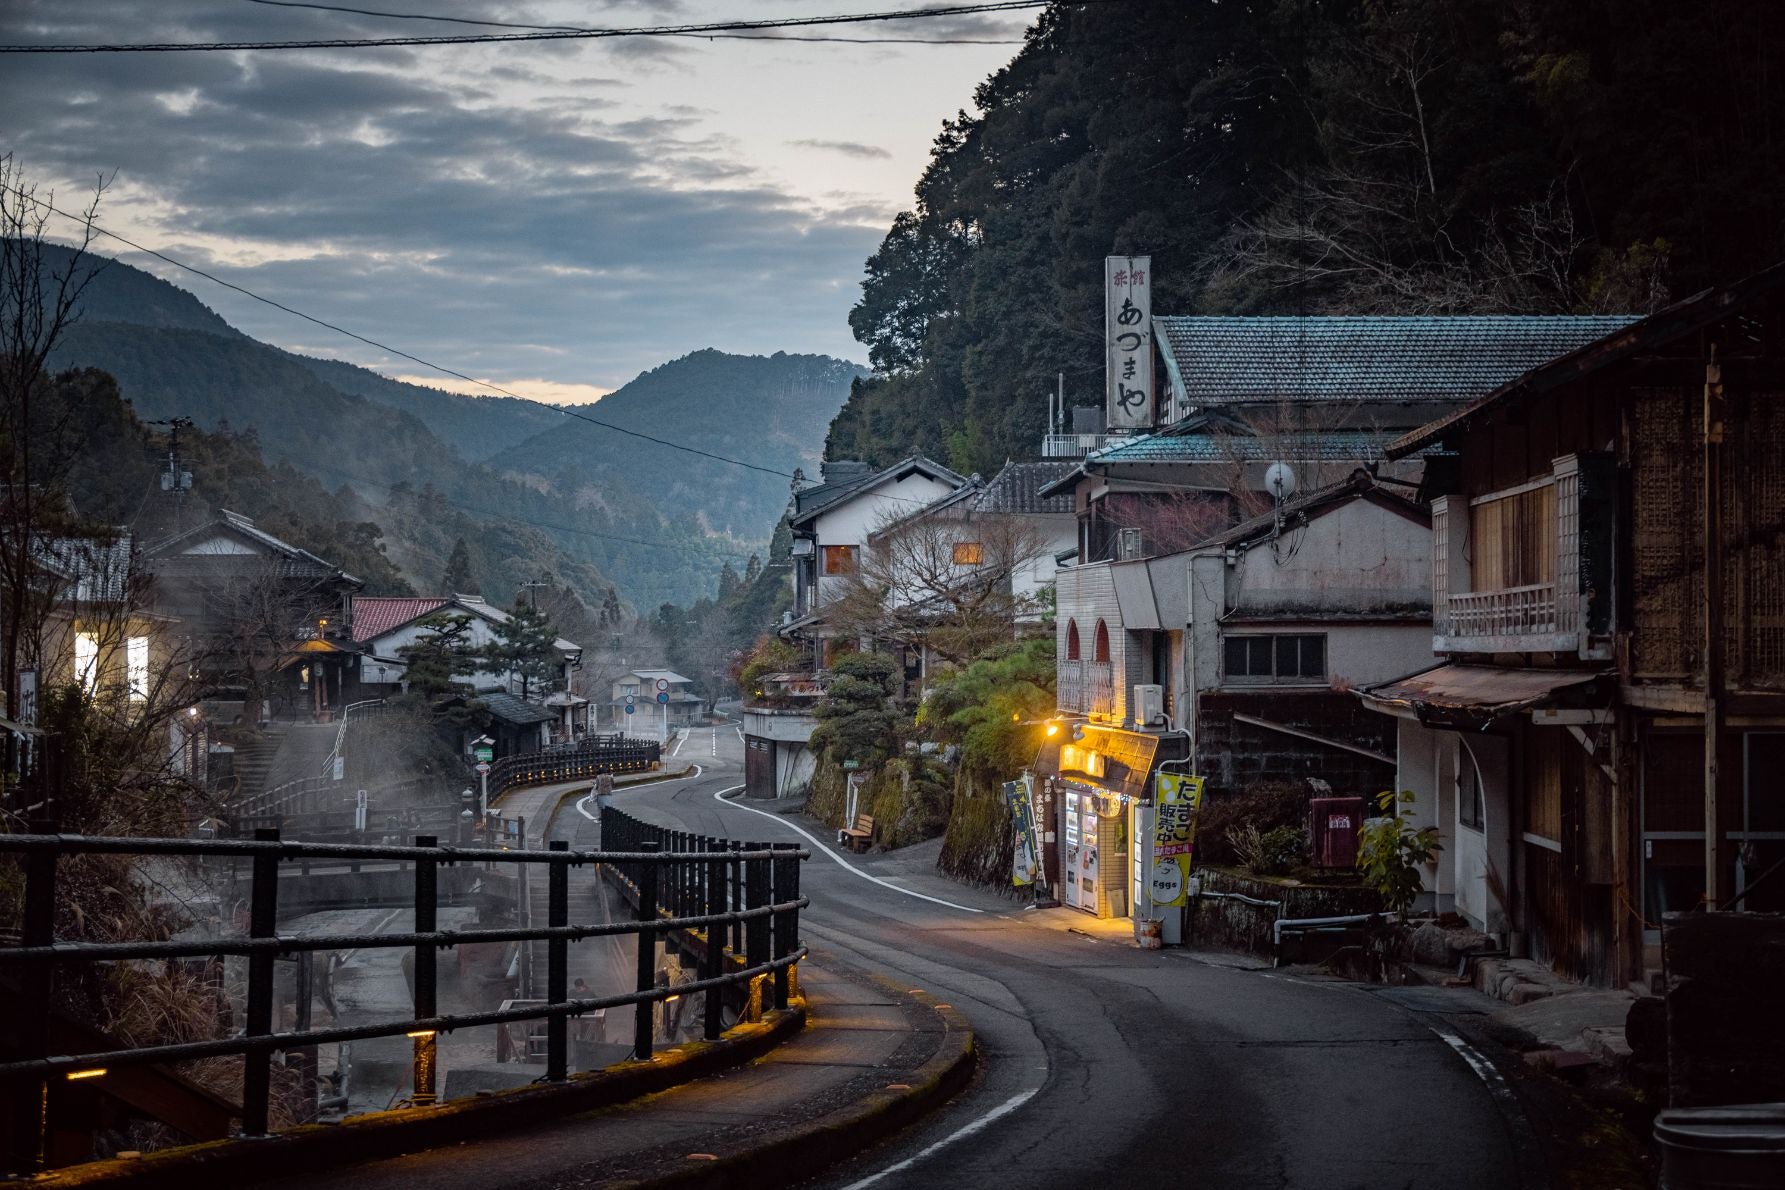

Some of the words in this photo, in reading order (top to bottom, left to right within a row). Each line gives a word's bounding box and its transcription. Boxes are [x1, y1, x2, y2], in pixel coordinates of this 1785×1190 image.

[1116, 297, 1149, 418] あづまや
[1157, 803, 1177, 845] 販売中
[1153, 880, 1177, 890] Eggs
